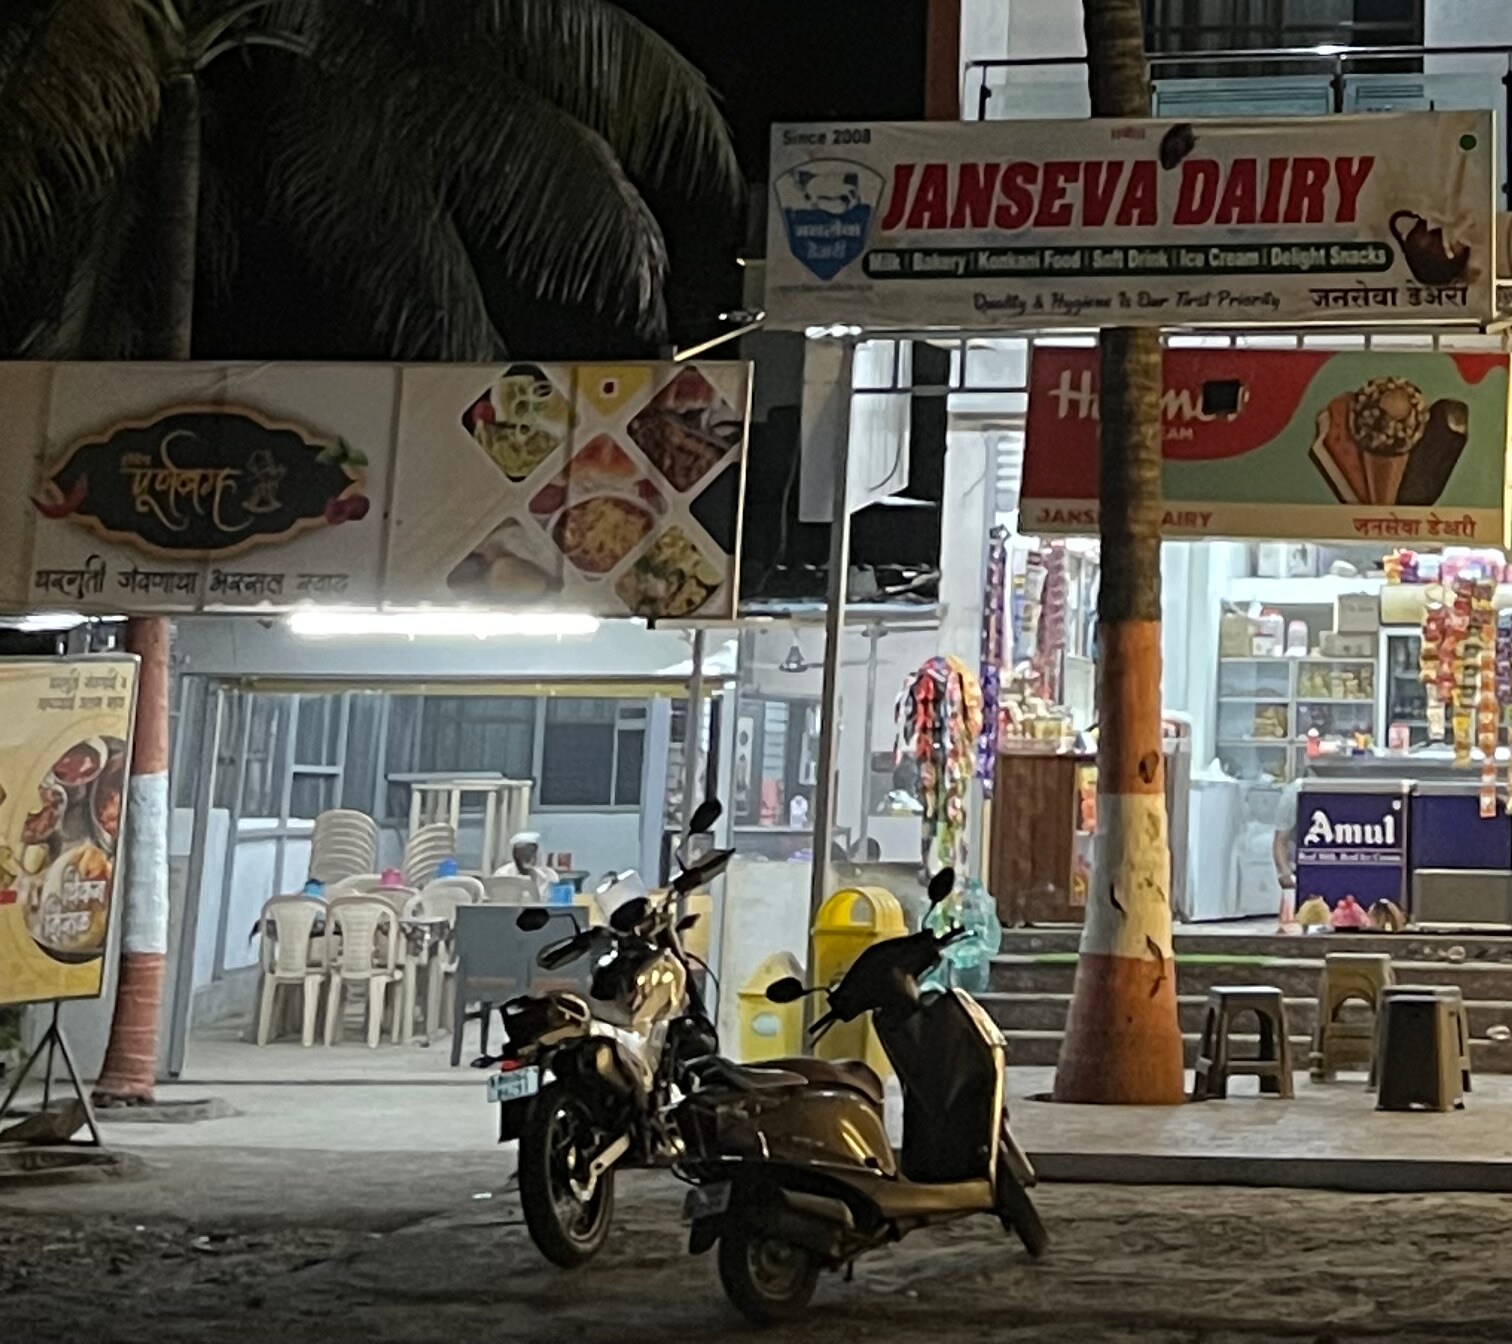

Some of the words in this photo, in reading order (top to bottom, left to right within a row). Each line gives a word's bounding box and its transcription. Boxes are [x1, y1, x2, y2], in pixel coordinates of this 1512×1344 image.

[783, 130, 827, 145] Since
[881, 160, 1158, 231] JANSEVA
[1173, 156, 1376, 226] DAIRY
[912, 251, 967, 274] Bakery
[1044, 249, 1081, 268] Food
[1093, 249, 1124, 268] Soft
[1128, 249, 1168, 268] Drink
[1180, 249, 1205, 266] Ice
[1209, 248, 1259, 267] Cream
[1271, 247, 1325, 270] Delight
[1330, 245, 1387, 265] Snacks
[1218, 289, 1280, 311] Priority
[1037, 509, 1096, 525] JANS
[1162, 512, 1213, 528] AIRY
[1353, 512, 1422, 536] जनसेवा
[1303, 810, 1396, 846] Amul
